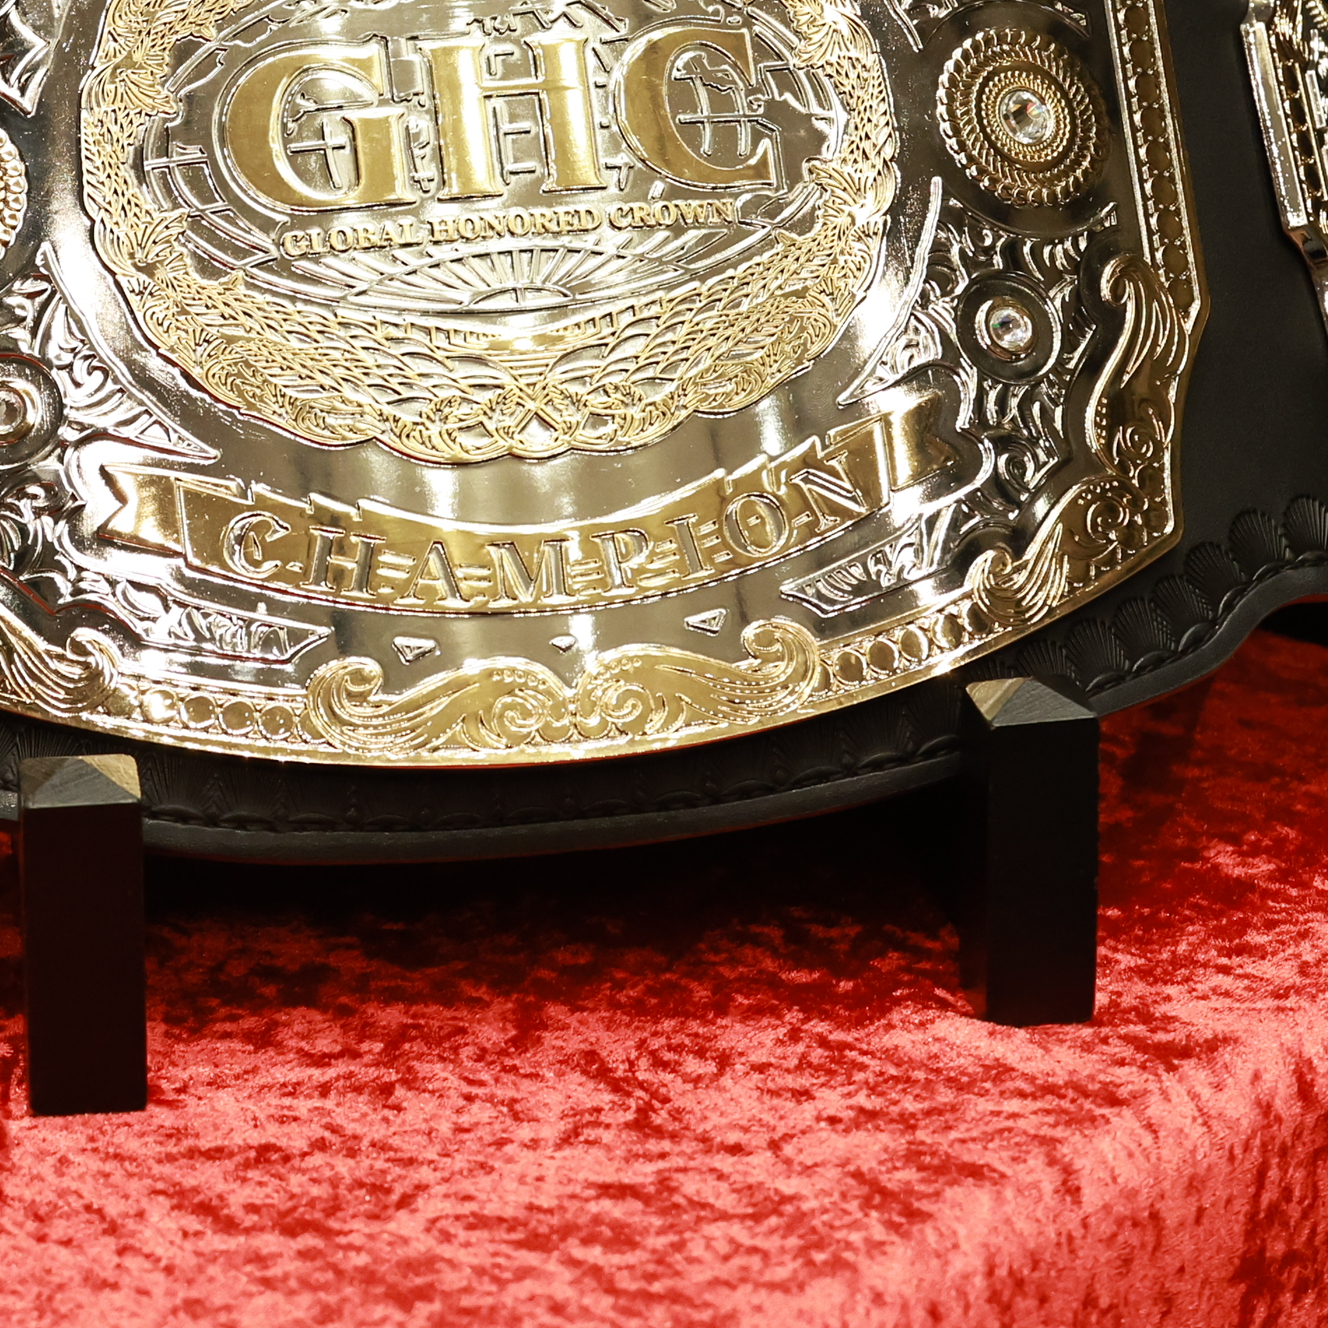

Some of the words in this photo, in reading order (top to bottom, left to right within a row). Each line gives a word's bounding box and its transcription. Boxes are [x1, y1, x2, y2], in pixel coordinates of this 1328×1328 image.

[221, 16, 782, 214] GHC
[280, 217, 424, 258] GLOBAL
[428, 204, 603, 242] HONORED
[608, 198, 738, 230] CROWN
[219, 448, 869, 608] CHAMPION
